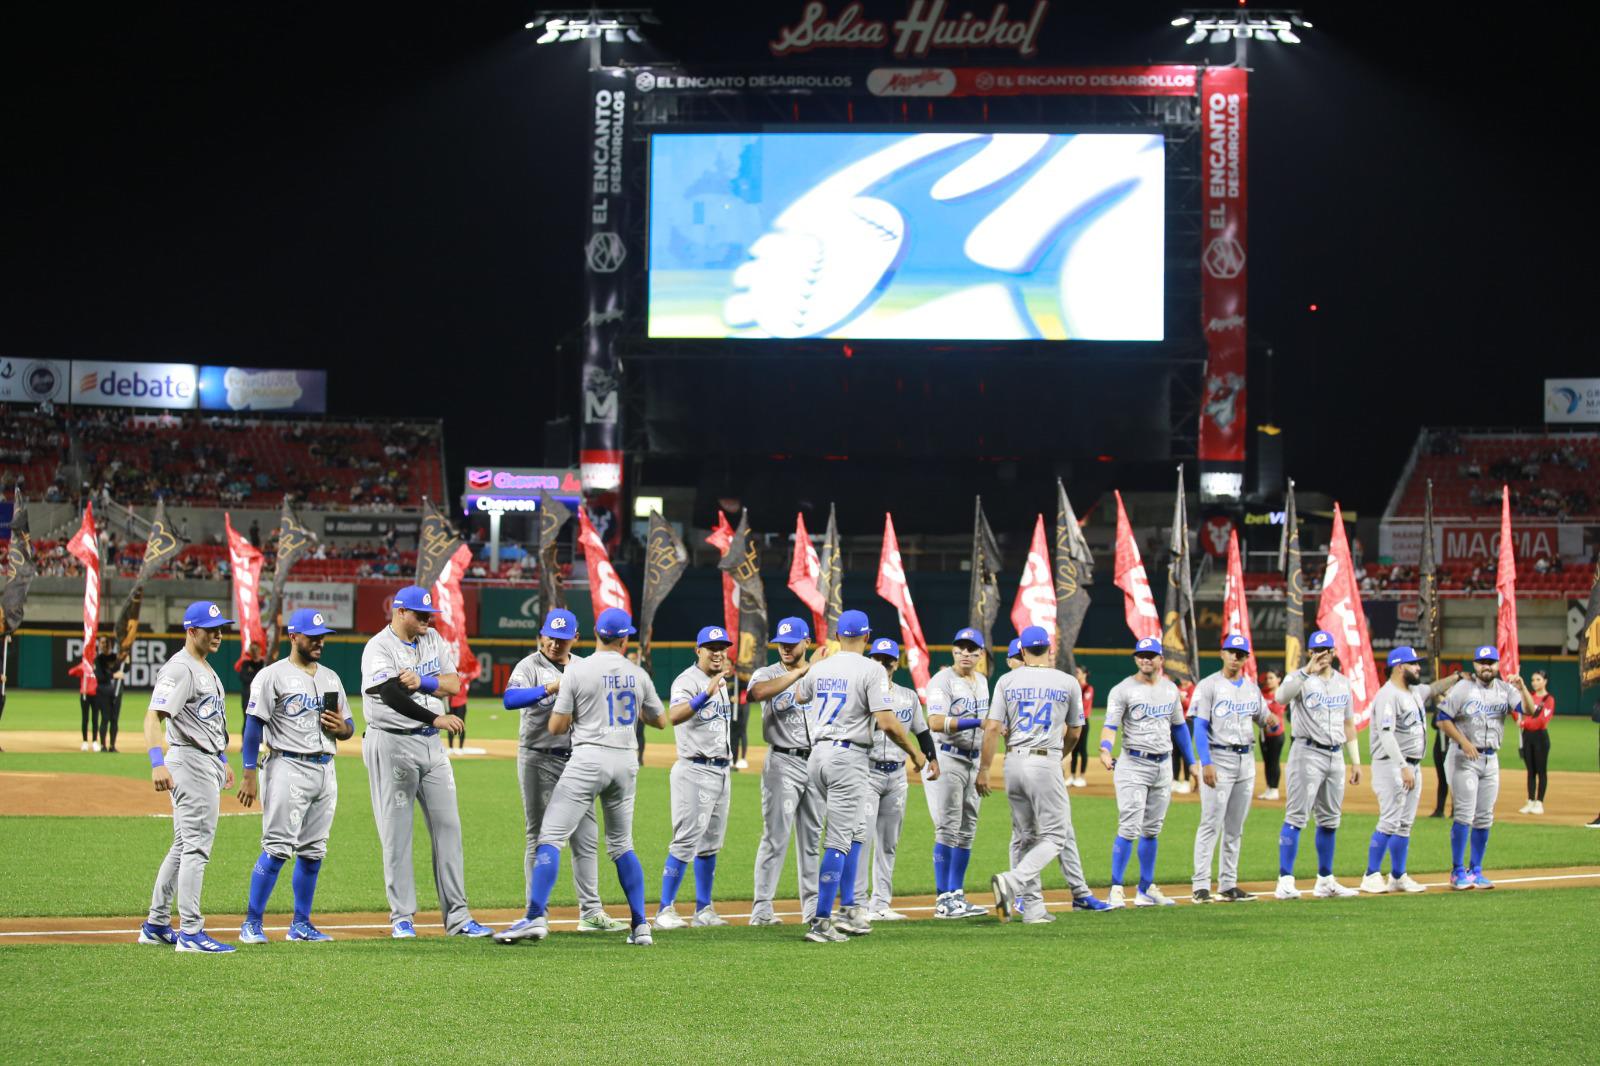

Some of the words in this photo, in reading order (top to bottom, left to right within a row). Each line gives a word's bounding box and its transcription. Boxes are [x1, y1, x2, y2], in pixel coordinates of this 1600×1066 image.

[769, 0, 886, 55] Salsa
[893, 0, 1048, 56] Huichol
[656, 76, 676, 89] EL
[677, 76, 745, 89] ENCANTO
[749, 75, 852, 88] DESARROLLOS
[997, 75, 1014, 87] EL
[1017, 75, 1086, 87] ENCANTO
[1090, 74, 1195, 87] DESARROLLOS
[594, 90, 612, 194] ENCANTO
[611, 91, 625, 194] DESARROLLOS
[1210, 93, 1226, 199] ENCANTO
[1228, 94, 1240, 198] DESARROLLOS
[593, 199, 608, 224] EL
[1210, 204, 1225, 229] EL
[100, 372, 190, 398] debate
[477, 496, 535, 511] Chevron
[1244, 511, 1286, 524] betVI
[498, 617, 536, 629] Banco
[602, 675, 636, 689] TREJO
[816, 678, 849, 692] GUSMAN
[1004, 687, 1068, 703] CASTELLANOS
[606, 690, 637, 727] 13
[816, 692, 848, 725] 77
[1017, 700, 1053, 732] 54
